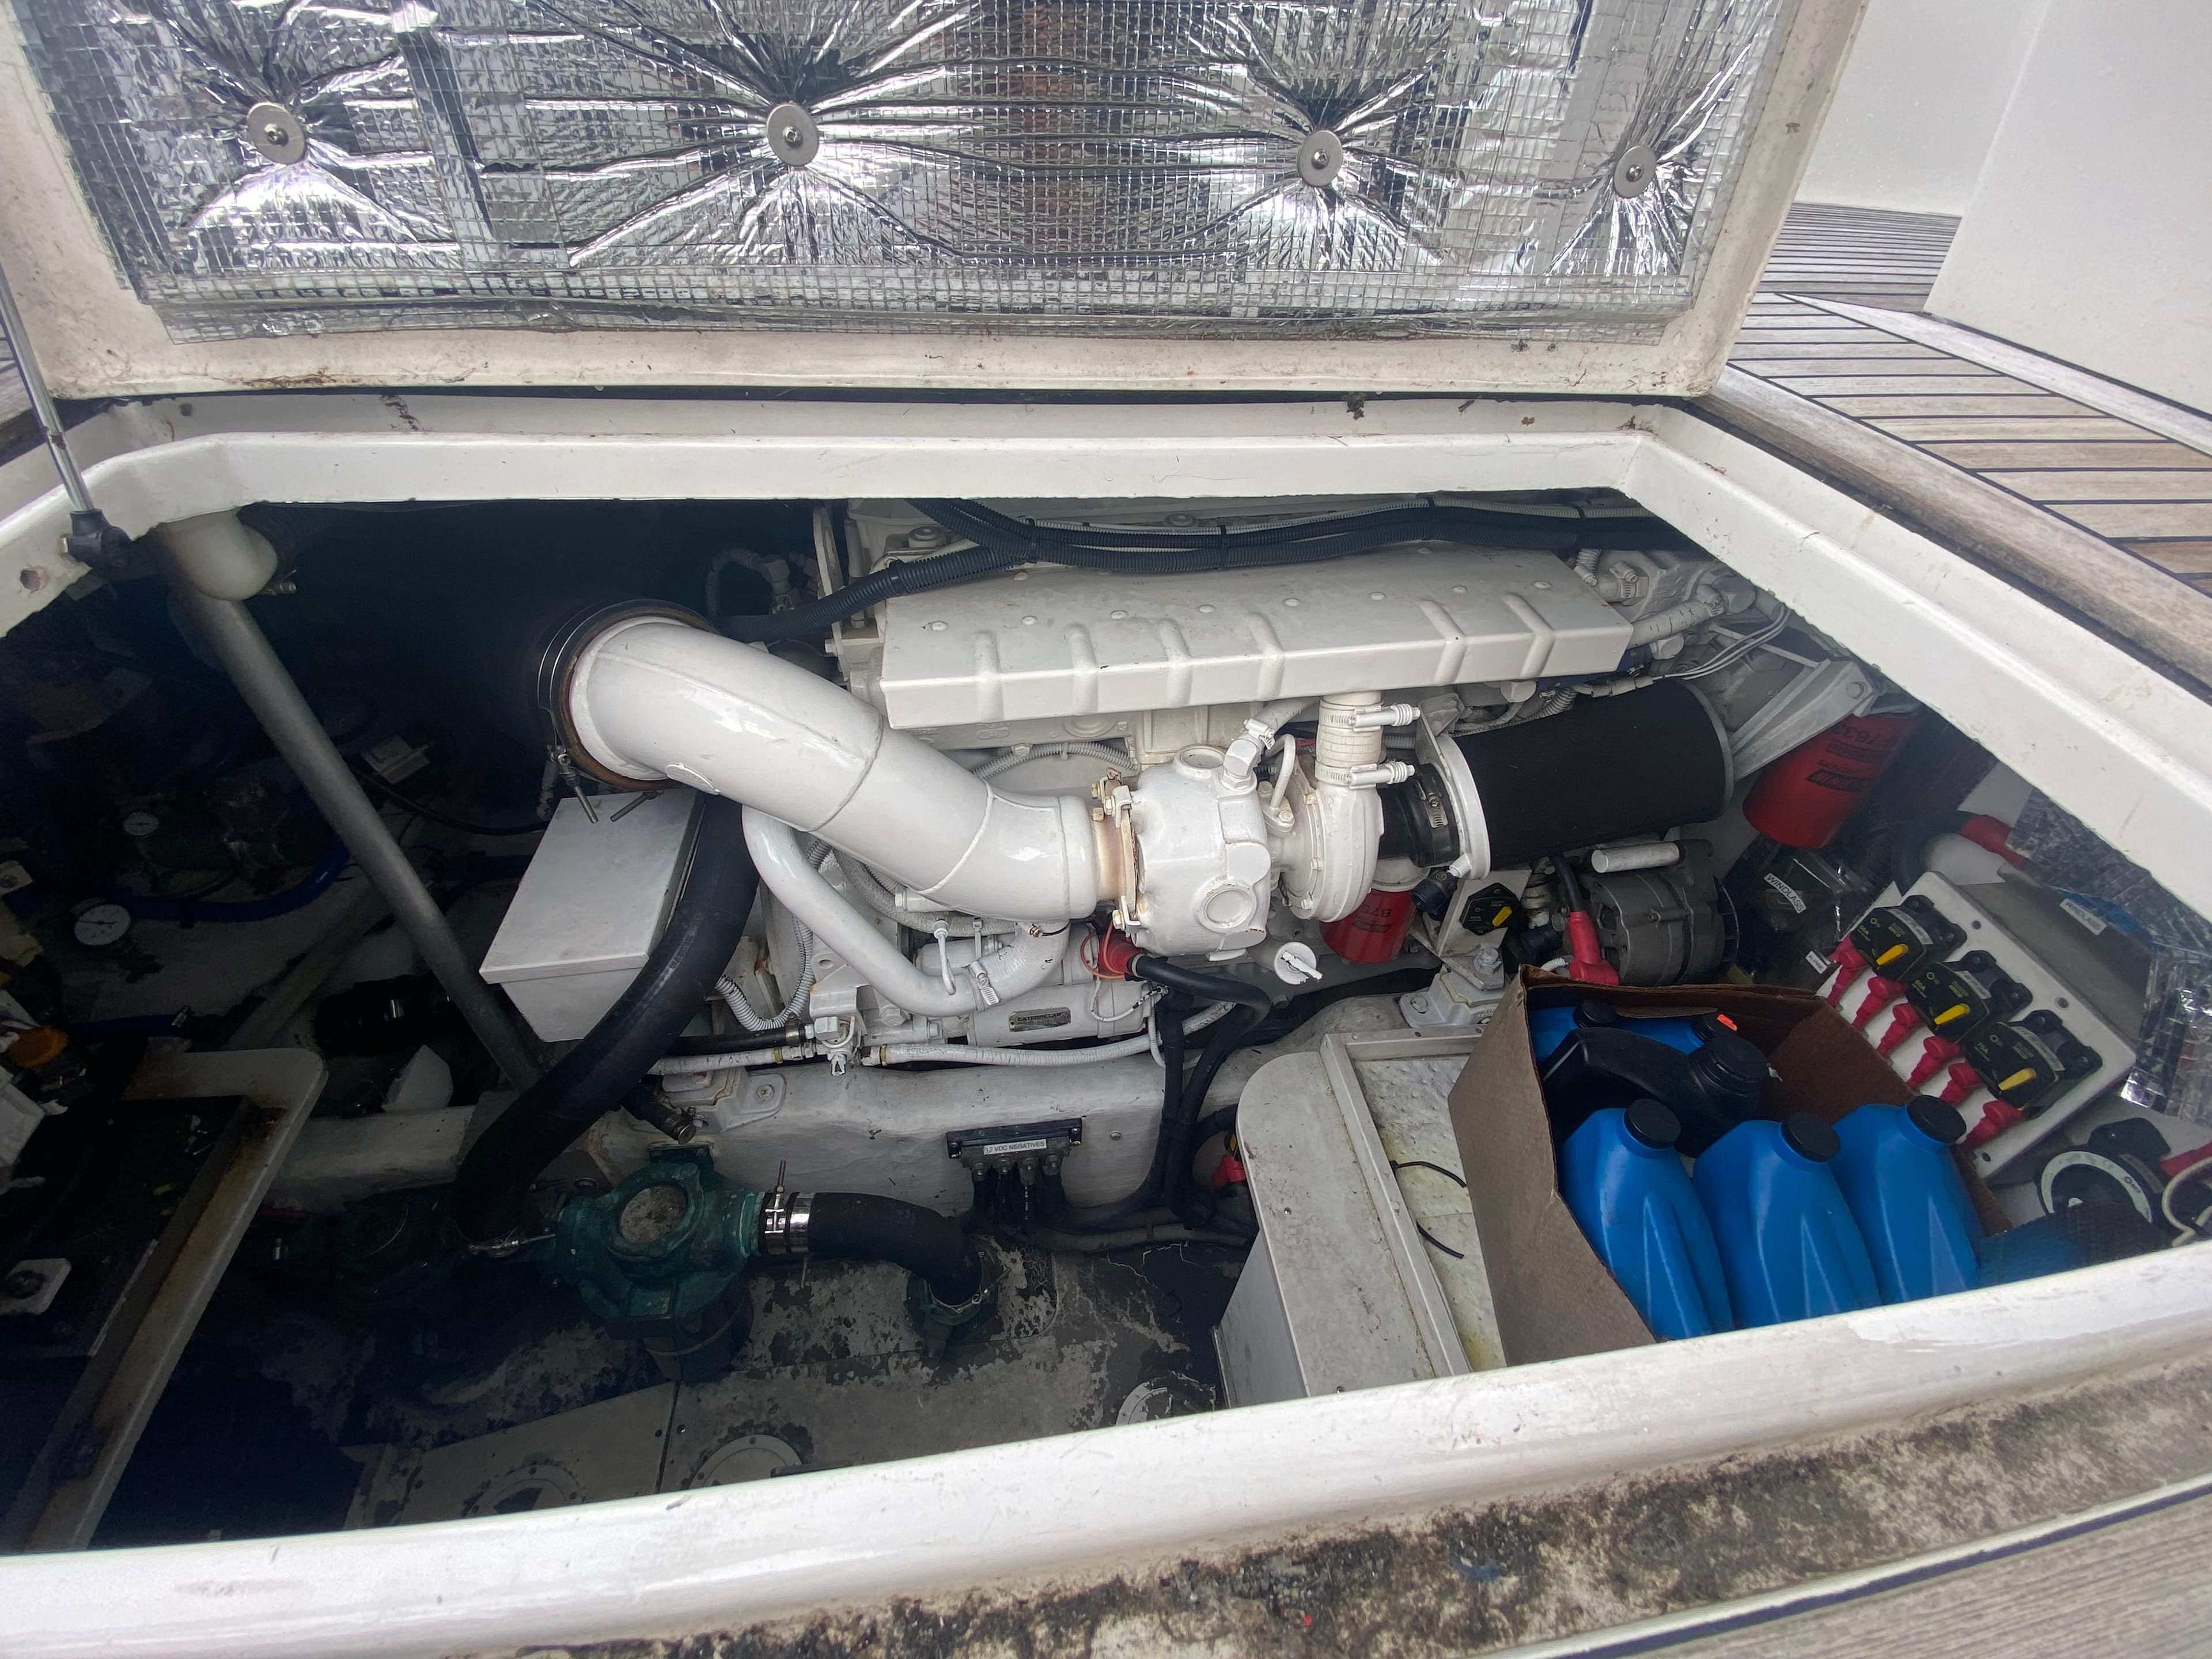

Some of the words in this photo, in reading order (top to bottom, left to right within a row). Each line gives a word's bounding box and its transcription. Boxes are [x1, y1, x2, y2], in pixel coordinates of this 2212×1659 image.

[1767, 875, 1804, 911] WINDLASS
[2065, 900, 2103, 931] WINDLASS
[1018, 1013, 1062, 1021] CATERPILLAR
[1009, 1141, 1044, 1150] NEGATIVES
